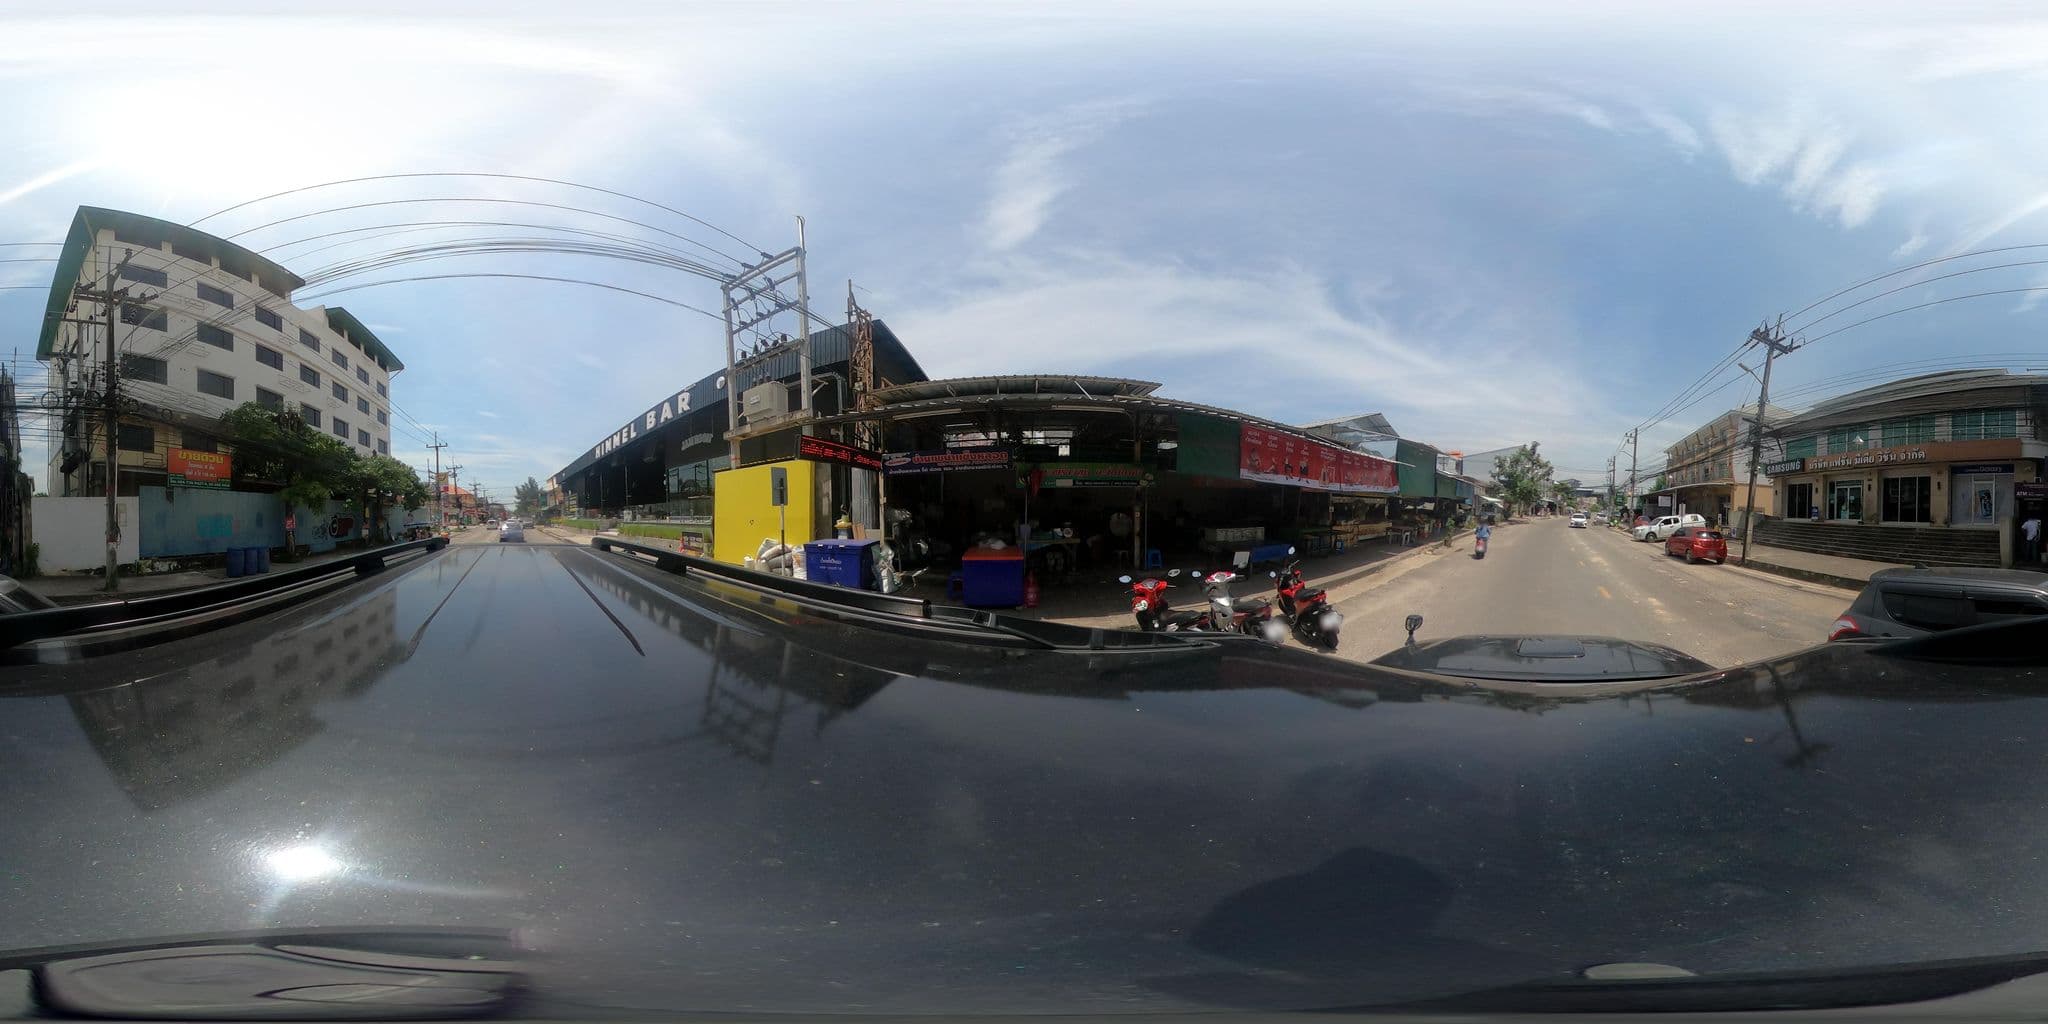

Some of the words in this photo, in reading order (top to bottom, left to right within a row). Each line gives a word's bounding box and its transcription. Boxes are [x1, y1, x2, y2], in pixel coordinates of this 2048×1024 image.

[646, 391, 691, 430] BAR
[1766, 460, 1801, 475] SAMSUNG
[1809, 459, 1828, 469] บริษัท
[1899, 447, 1926, 461] จำกัด
